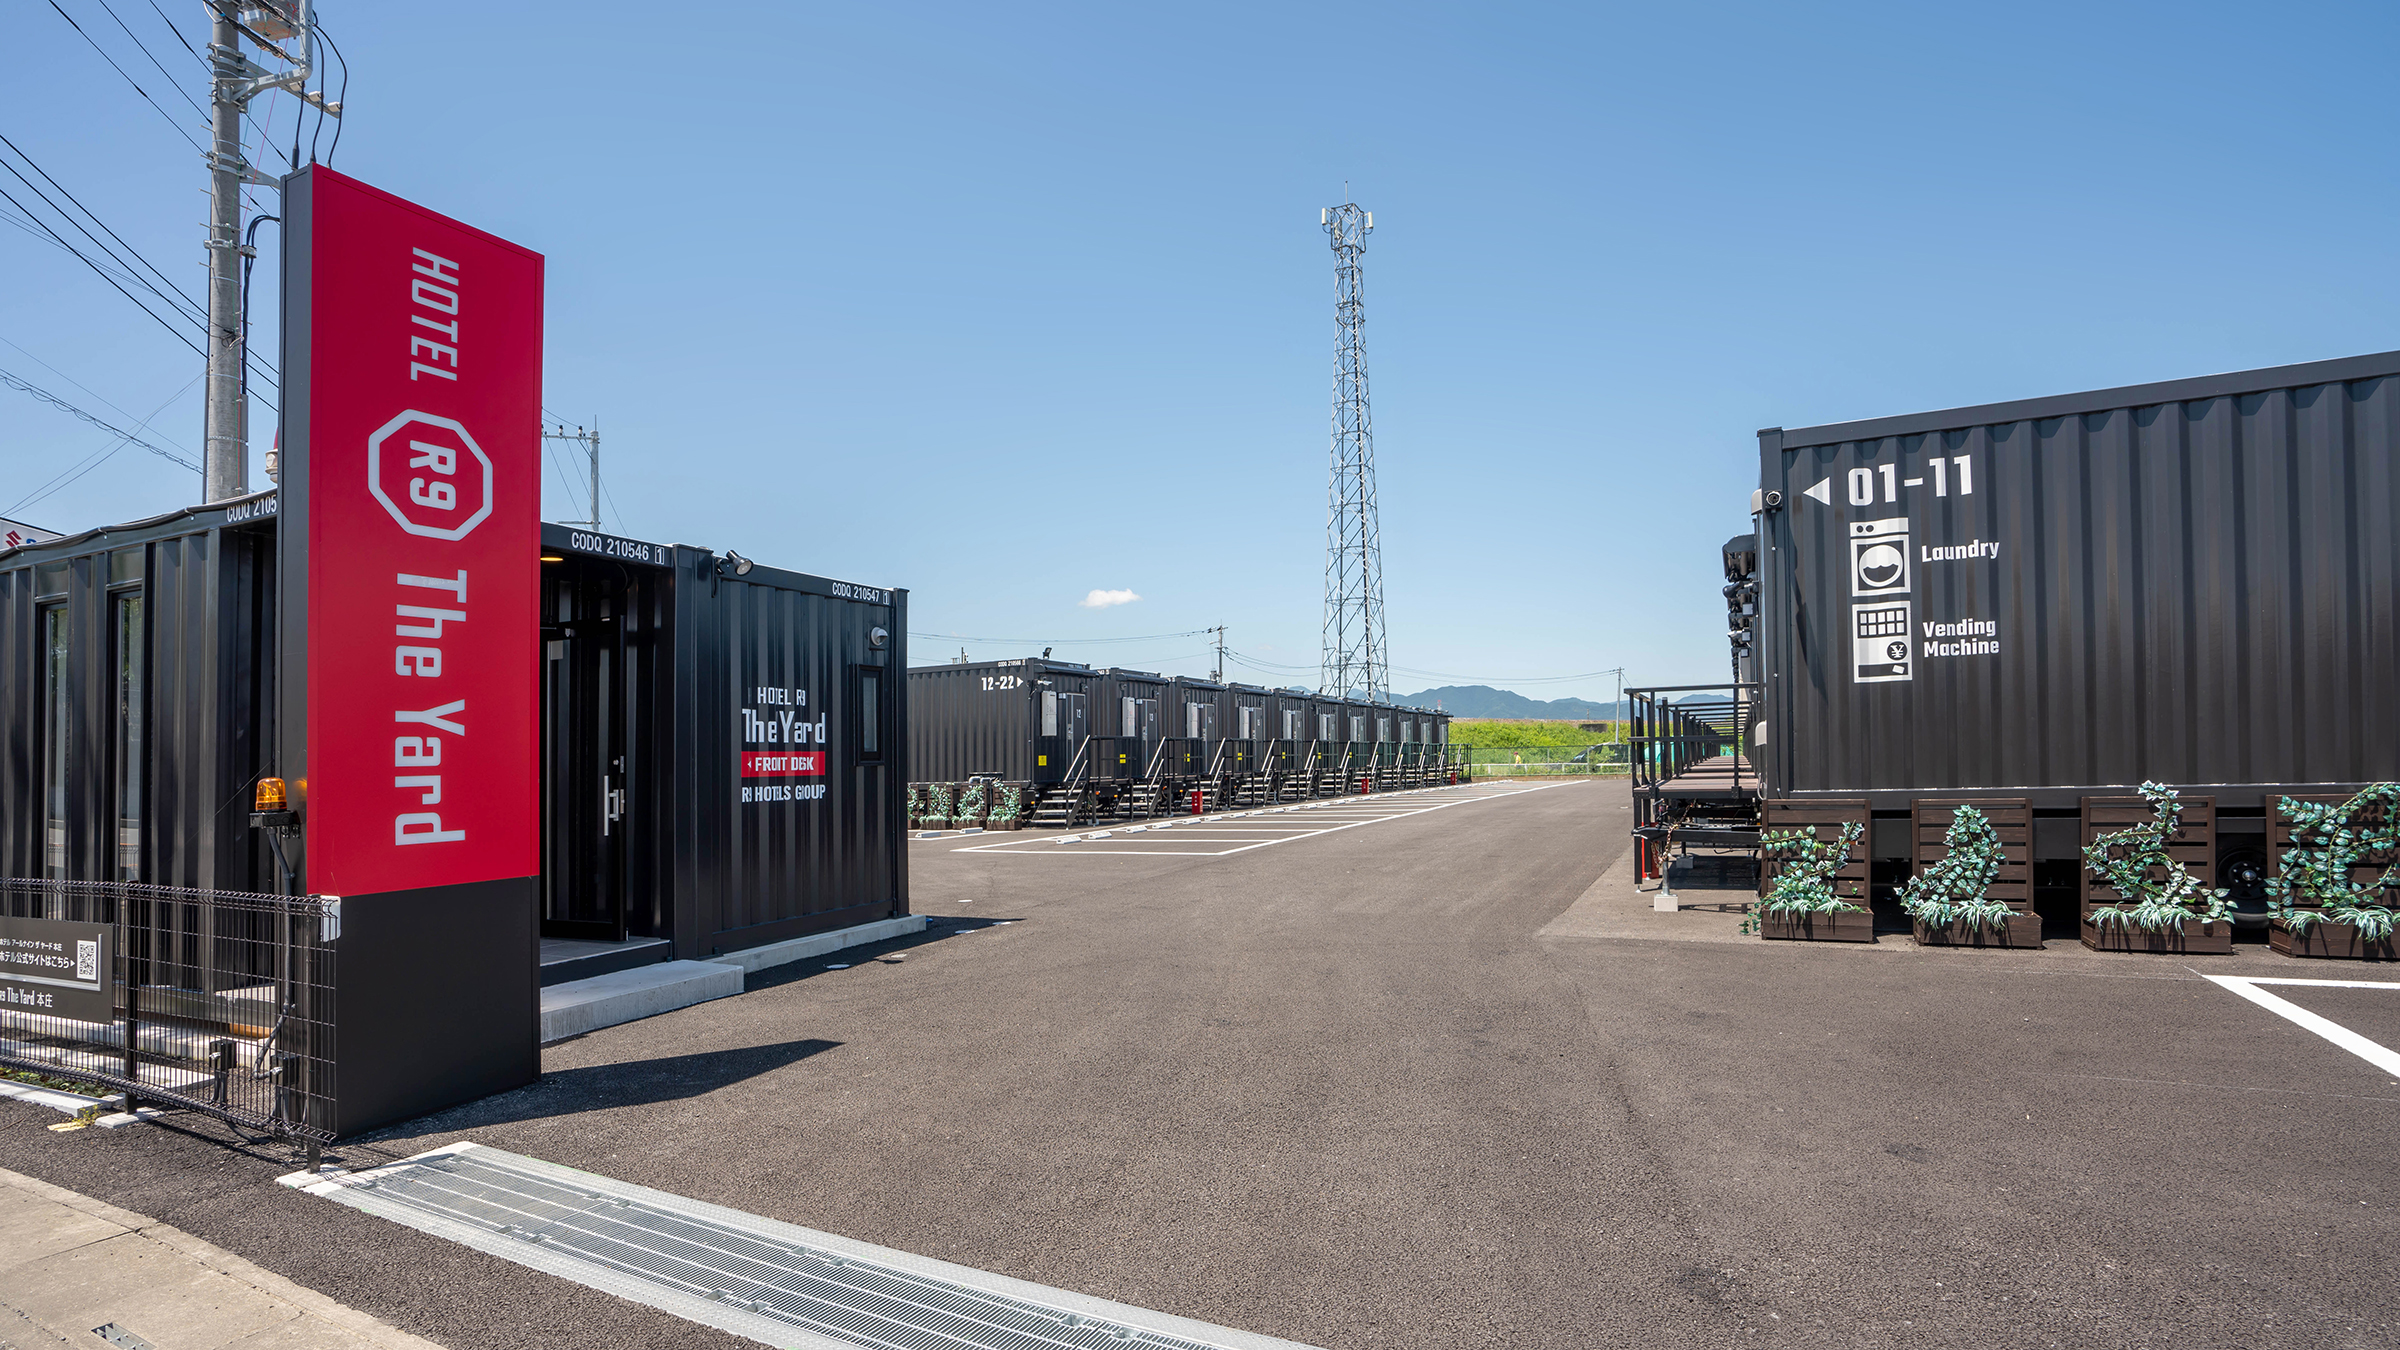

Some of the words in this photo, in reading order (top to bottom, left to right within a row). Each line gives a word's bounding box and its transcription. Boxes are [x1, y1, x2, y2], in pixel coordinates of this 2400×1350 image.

[411, 246, 459, 381] HOTEL
[410, 439, 457, 511] R9
[1847, 454, 1973, 506] 01-11
[571, 531, 603, 554] CODQ
[606, 538, 650, 561] 210546
[1921, 539, 2000, 563] Laundry
[832, 582, 852, 598] CODQ
[853, 585, 880, 603] 210547
[395, 569, 467, 677] The
[1923, 618, 1996, 638] Vending
[1923, 638, 2000, 658] Machine
[981, 675, 1014, 691] 12-22
[742, 708, 777, 743] The
[778, 710, 826, 743] Yard
[394, 699, 466, 846] Yard
[19, 988, 35, 1006] Yard
